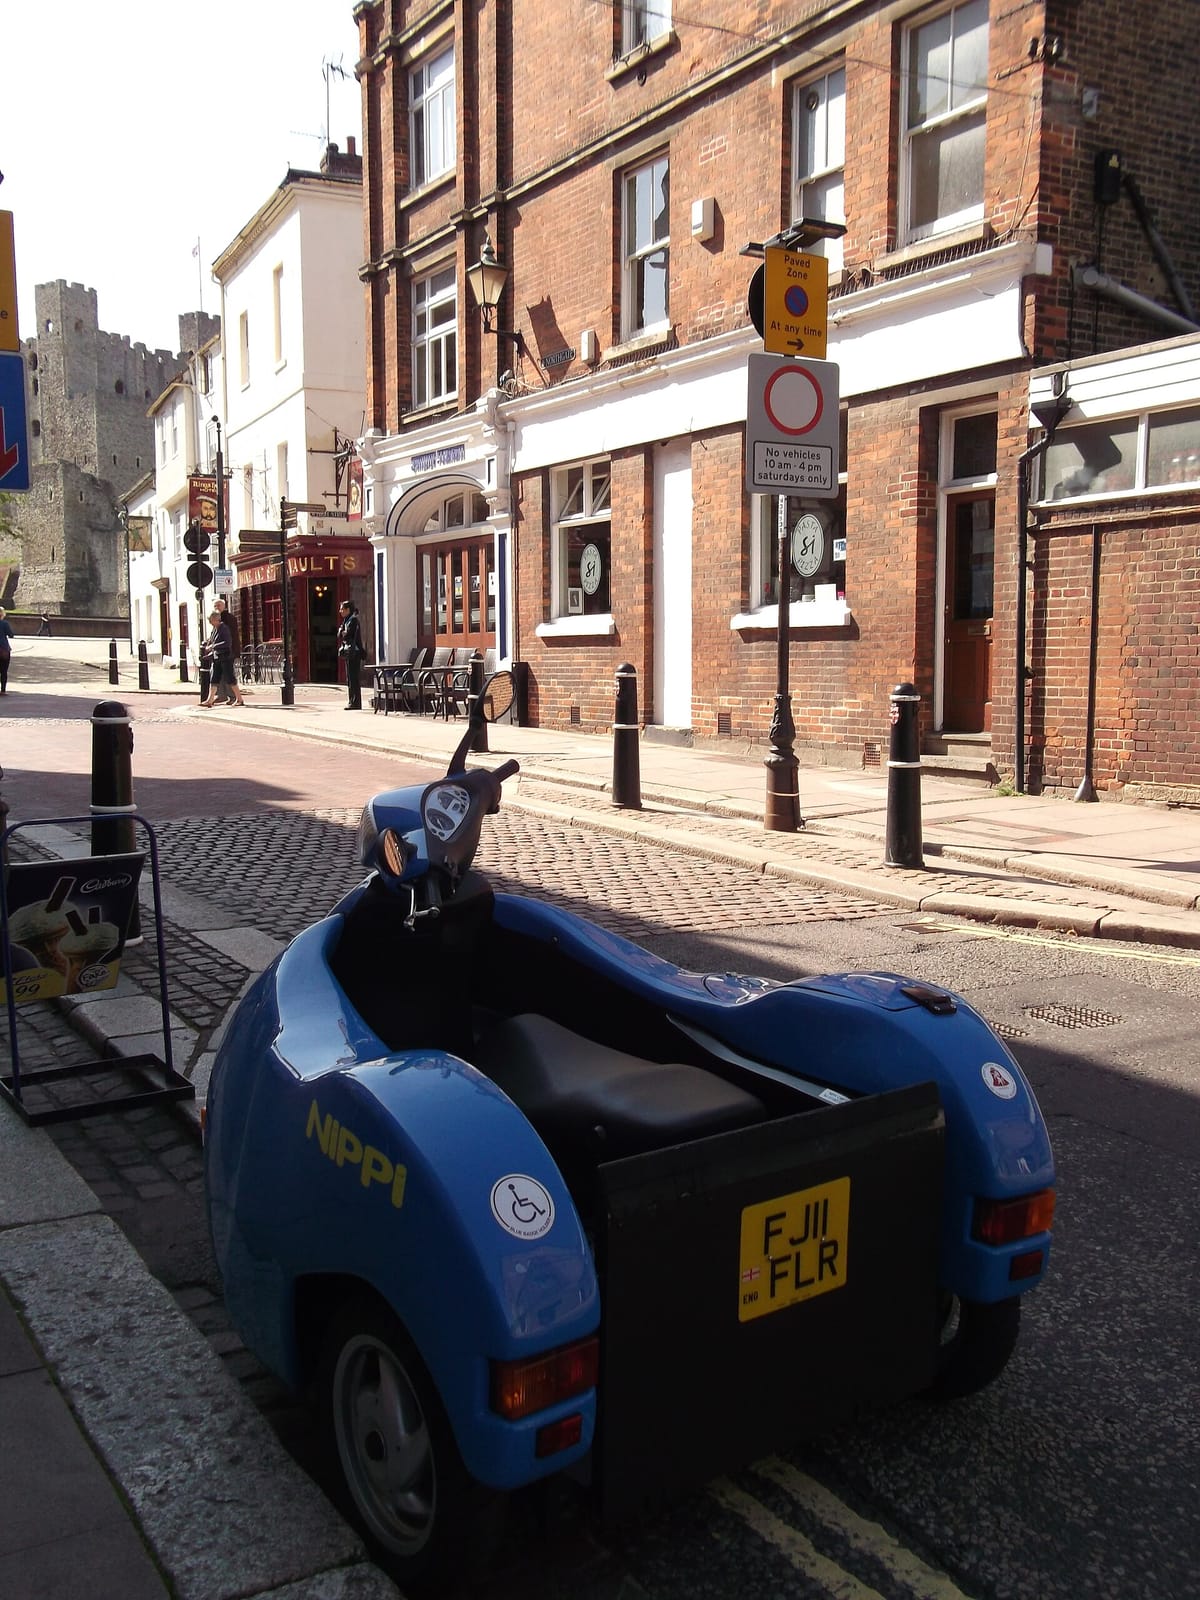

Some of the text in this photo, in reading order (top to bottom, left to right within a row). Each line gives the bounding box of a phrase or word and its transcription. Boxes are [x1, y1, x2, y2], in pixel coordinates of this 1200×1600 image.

[784, 254, 811, 268] Paved
[786, 267, 808, 280] Zone
[770, 320, 822, 337] At any time
[766, 447, 821, 460] No vehicles
[765, 459, 776, 469] 10
[778, 461, 792, 470] am
[799, 461, 806, 471] 4
[807, 464, 822, 473] pm
[758, 471, 828, 486] saturdays only
[797, 520, 818, 534] PASTA
[15, 982, 40, 998] 99
[306, 1098, 407, 1208] NIPPI
[764, 1199, 828, 1256] FJ11
[769, 1240, 839, 1299] FLR
